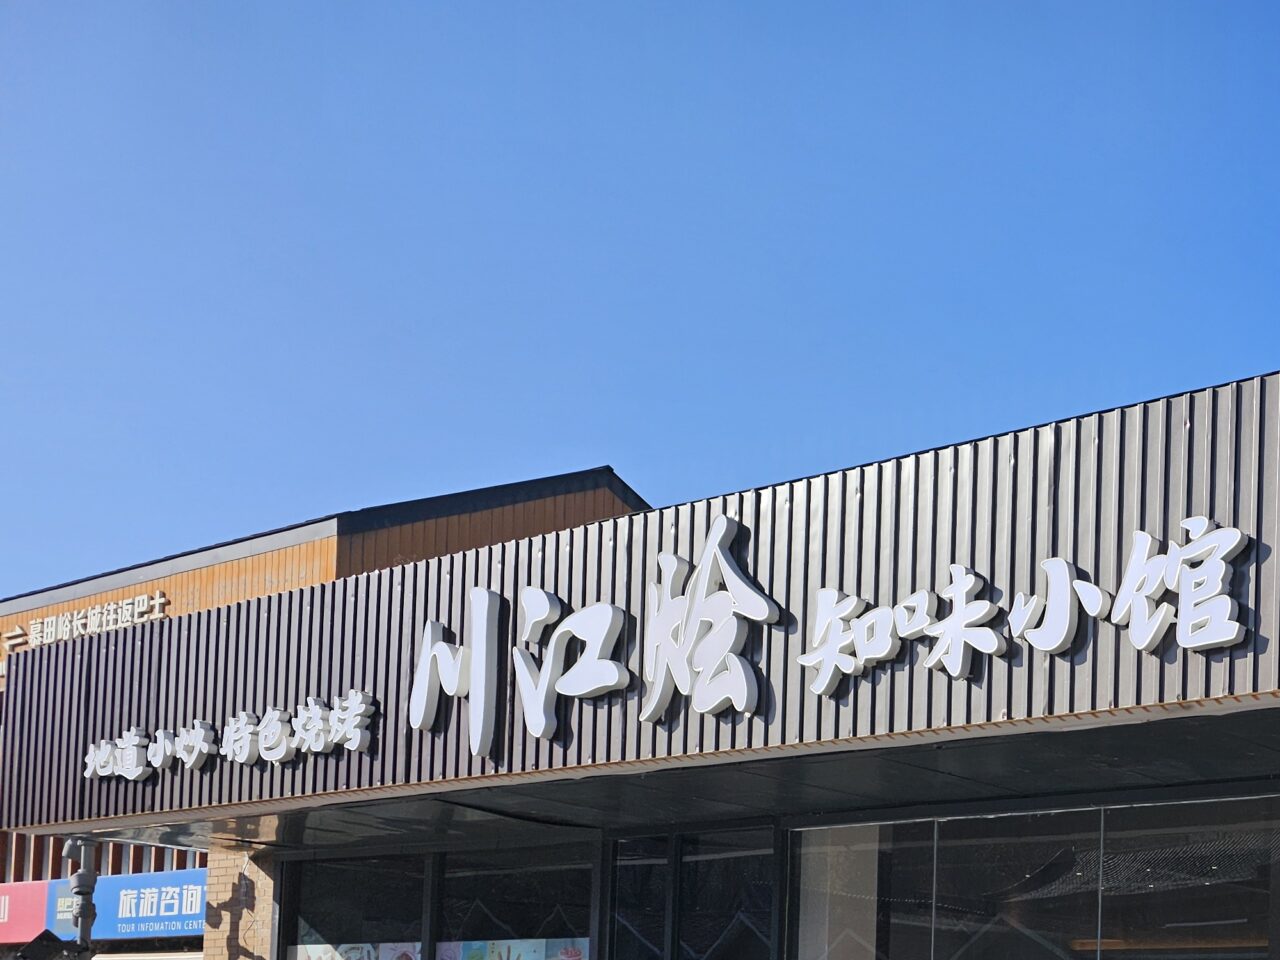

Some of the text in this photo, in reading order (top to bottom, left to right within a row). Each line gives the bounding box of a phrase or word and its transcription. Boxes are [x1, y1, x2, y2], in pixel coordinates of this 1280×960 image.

[28, 590, 170, 647] 慕田峪长城往返巴士
[800, 515, 1249, 697] 知味小馆
[83, 689, 374, 781] 地道小炒 特色烧烤
[117, 923, 136, 933] TOUR
[137, 921, 182, 931] INFOMATION
[118, 885, 206, 918] 旅游咨询
